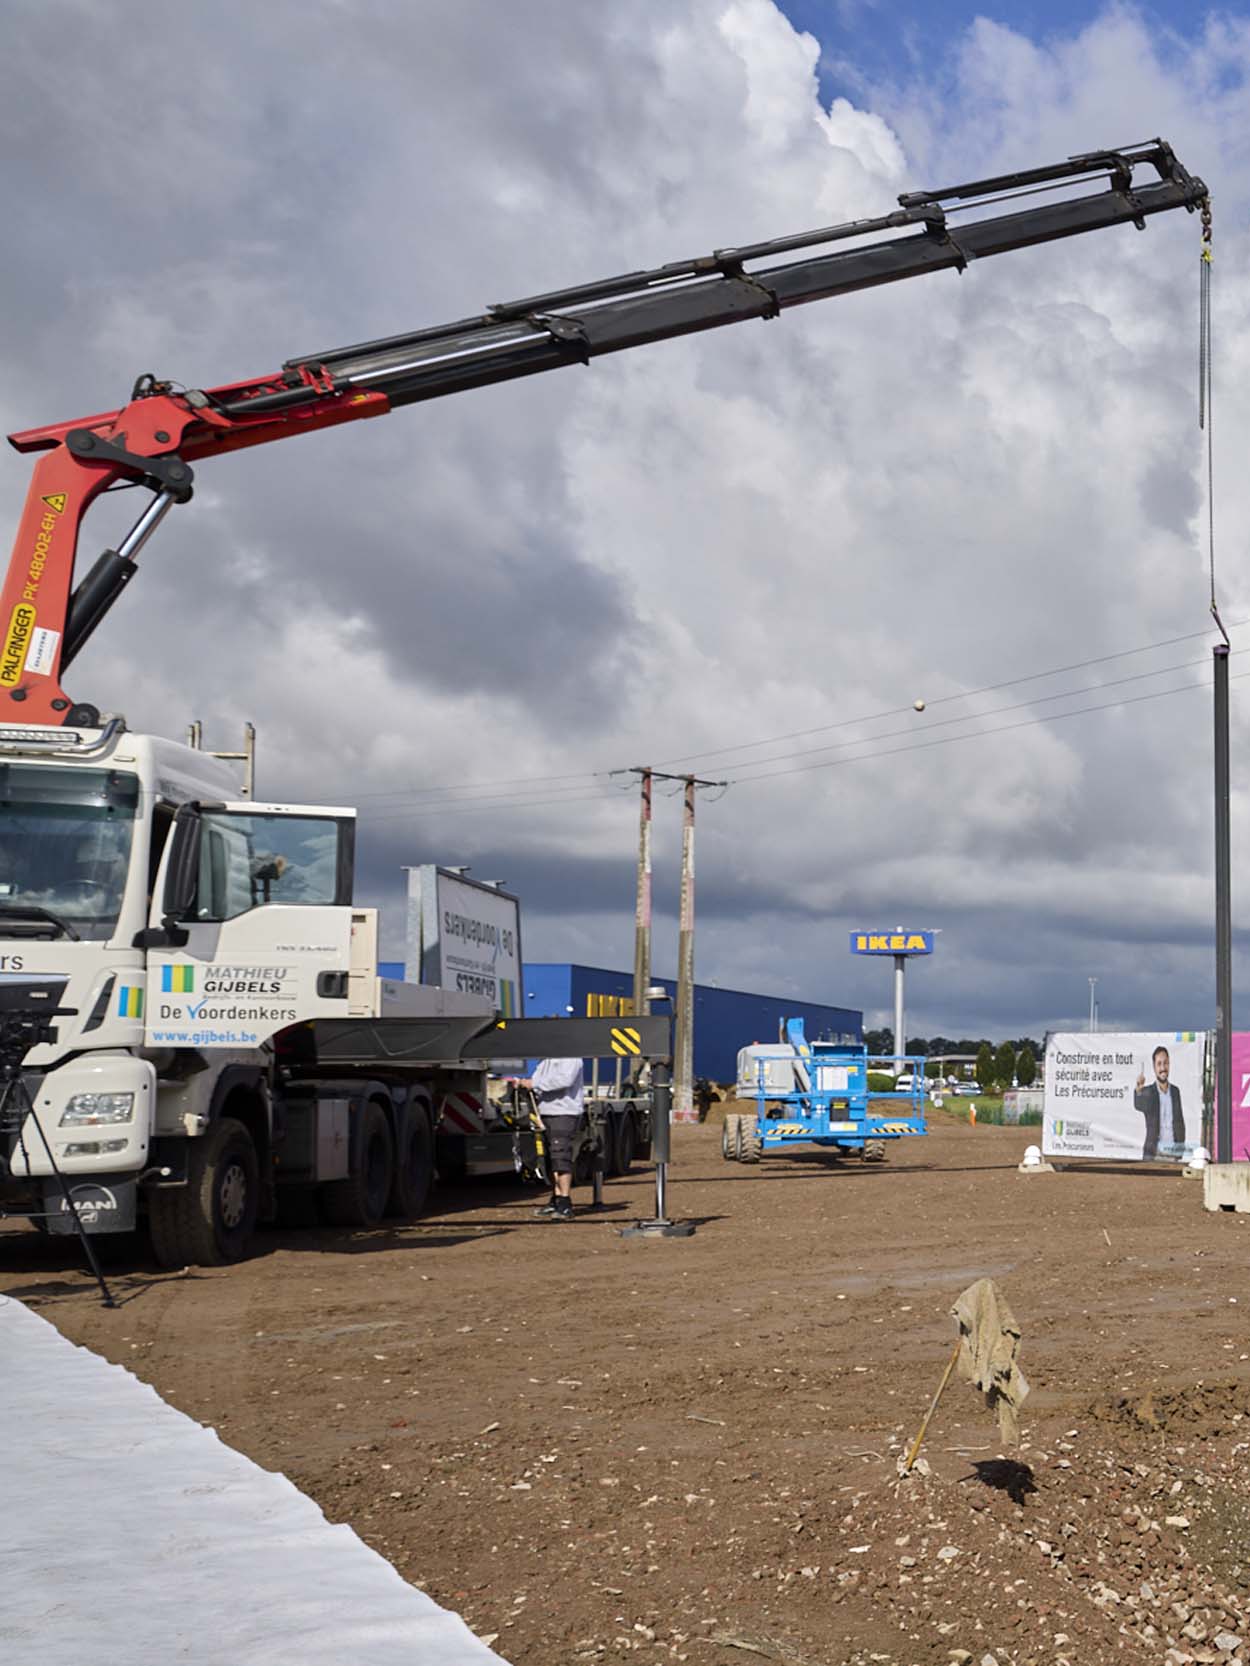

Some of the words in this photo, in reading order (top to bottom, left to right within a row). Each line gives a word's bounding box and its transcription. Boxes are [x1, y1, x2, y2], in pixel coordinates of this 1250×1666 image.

[29, 512, 56, 580] 48002-EH
[23, 582, 40, 600] PK
[1, 608, 33, 682] PALFINGER
[857, 936, 926, 950] IKEA
[205, 967, 287, 980] MATHIEU
[204, 981, 281, 993] GIJBELS
[160, 1005, 182, 1019] De
[186, 998, 297, 1020] Voordenkers
[152, 1030, 257, 1045] www.gijbels.be
[1102, 1054, 1113, 1065] en
[1115, 1052, 1133, 1065] tout
[1055, 1067, 1090, 1081] sécurité
[1091, 1070, 1113, 1081] avec
[1055, 1085, 1070, 1097] Les
